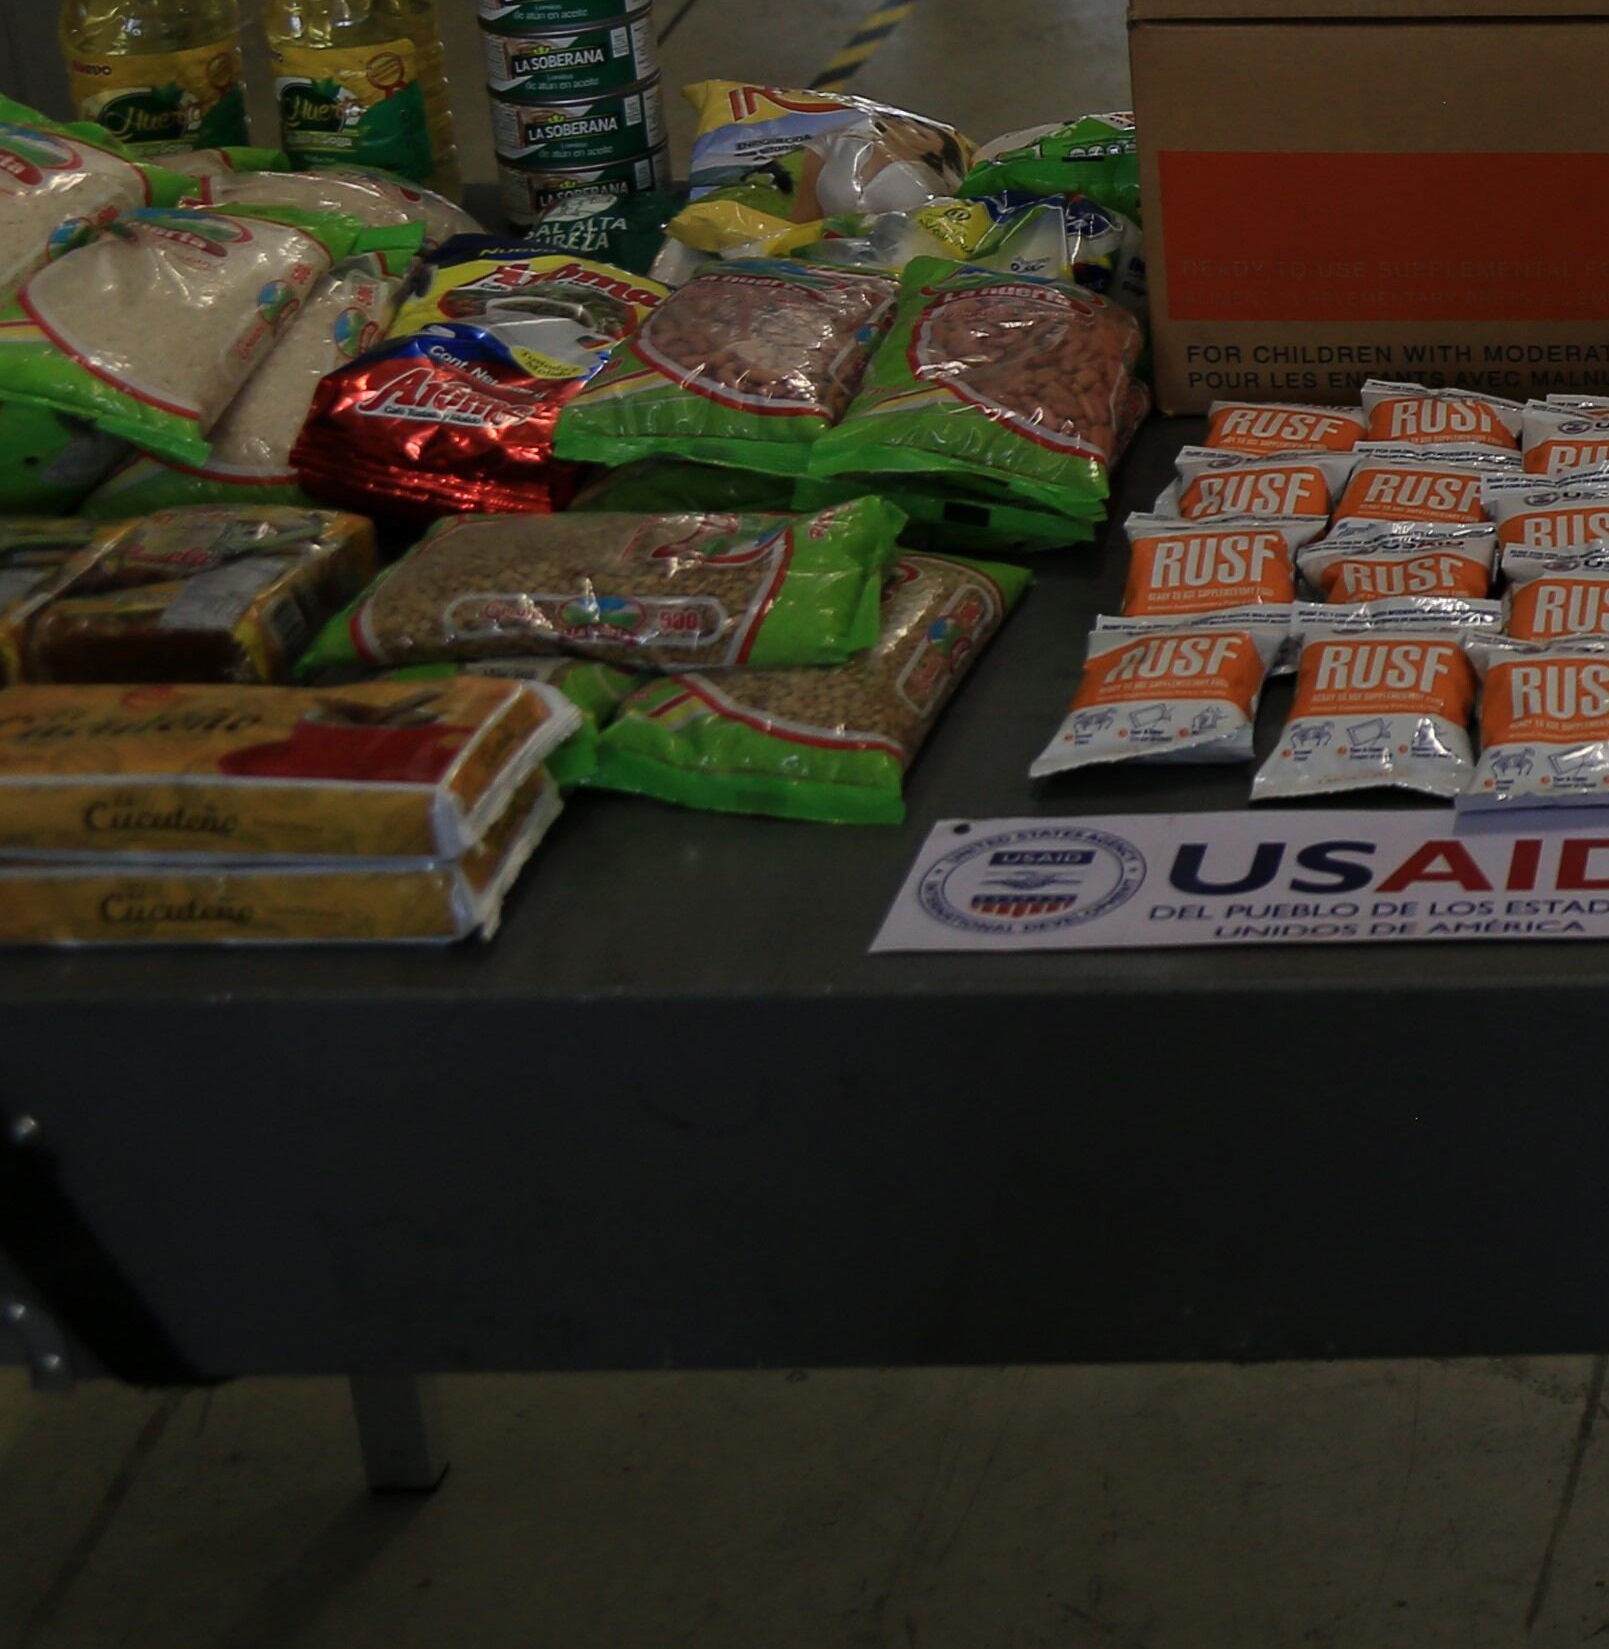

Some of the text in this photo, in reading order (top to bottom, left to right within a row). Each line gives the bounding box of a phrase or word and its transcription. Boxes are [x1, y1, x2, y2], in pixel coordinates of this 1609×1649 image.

[514, 48, 604, 72] LA SOBERANA
[1187, 345, 1240, 363] FOR
[1253, 345, 1392, 365] CHILDREN
[1402, 344, 1472, 367] WITH
[1222, 409, 1343, 439] RUSF
[1151, 531, 1278, 588] RUSF
[1316, 645, 1451, 692] RUSF
[1001, 851, 1084, 863] USAID
[1148, 904, 1212, 921] DEL
[1224, 901, 1360, 920] PUEBLO
[1370, 901, 1417, 918] DE
[1428, 900, 1493, 917] LOS
[1214, 919, 1586, 939] UNIDOS DE AMÉRICA
